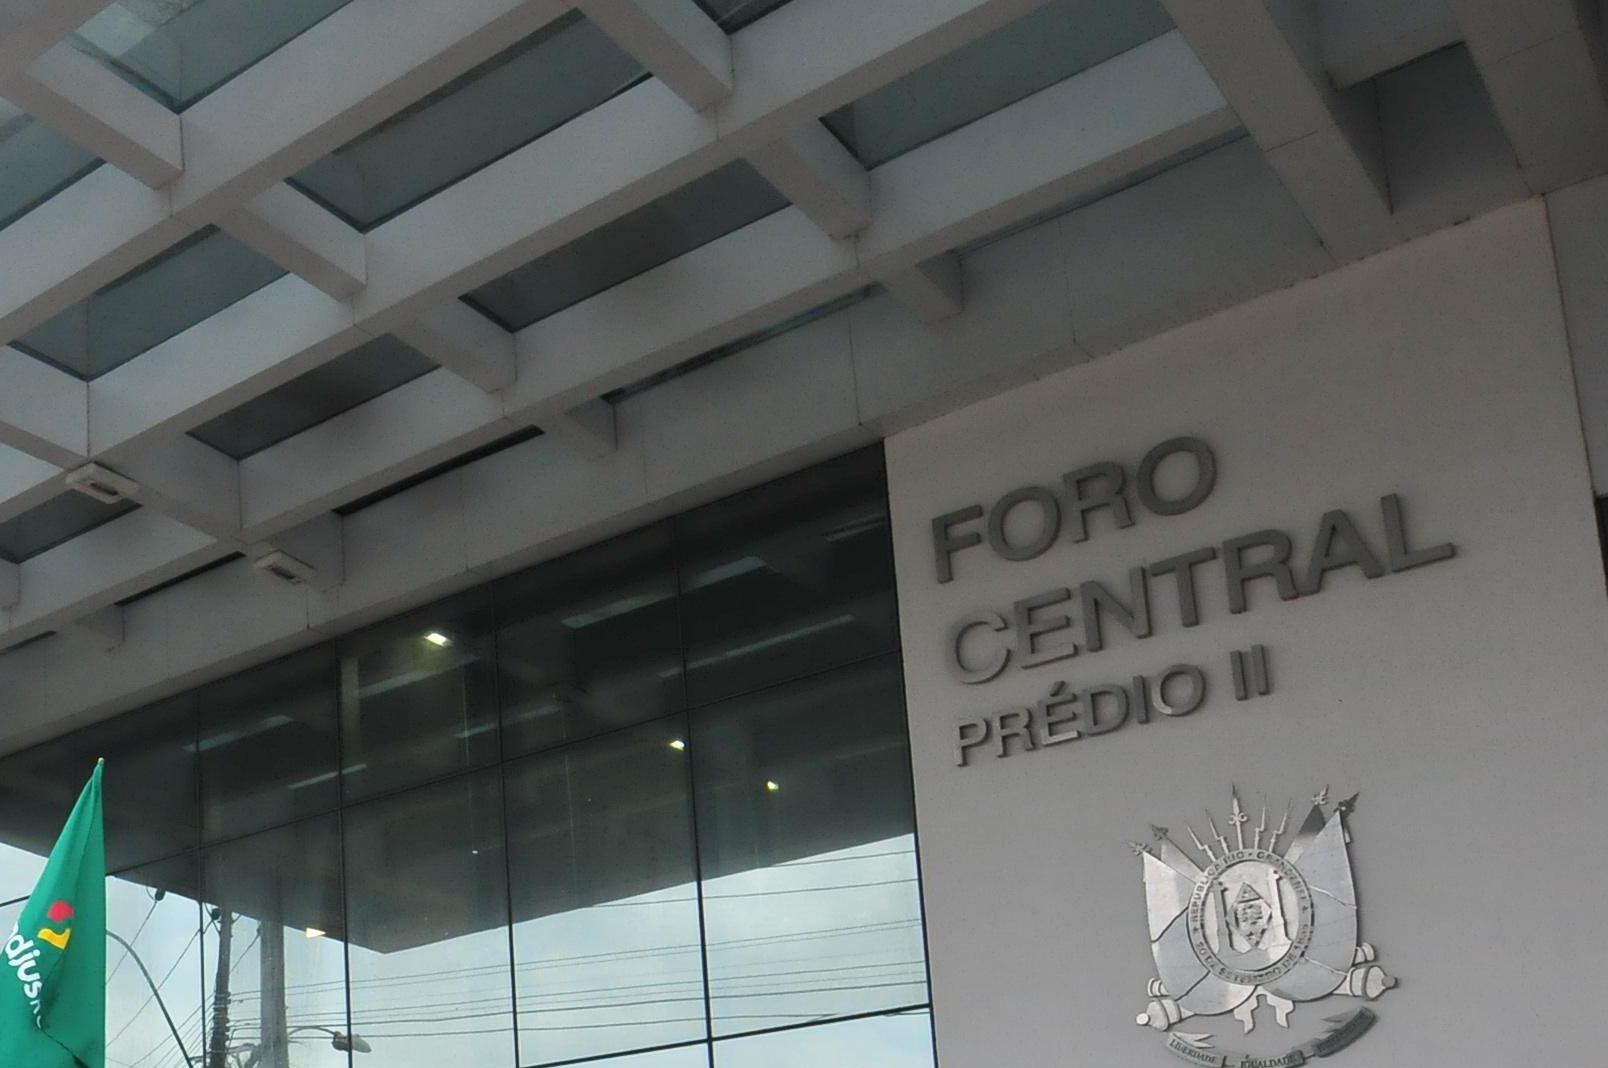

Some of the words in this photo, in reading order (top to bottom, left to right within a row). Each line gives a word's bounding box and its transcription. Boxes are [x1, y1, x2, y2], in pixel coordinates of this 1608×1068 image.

[930, 436, 1217, 584] FORO
[946, 493, 1455, 685] CENTRAL
[954, 663, 1207, 767] PRÉDIO
[1230, 644, 1272, 700] II
